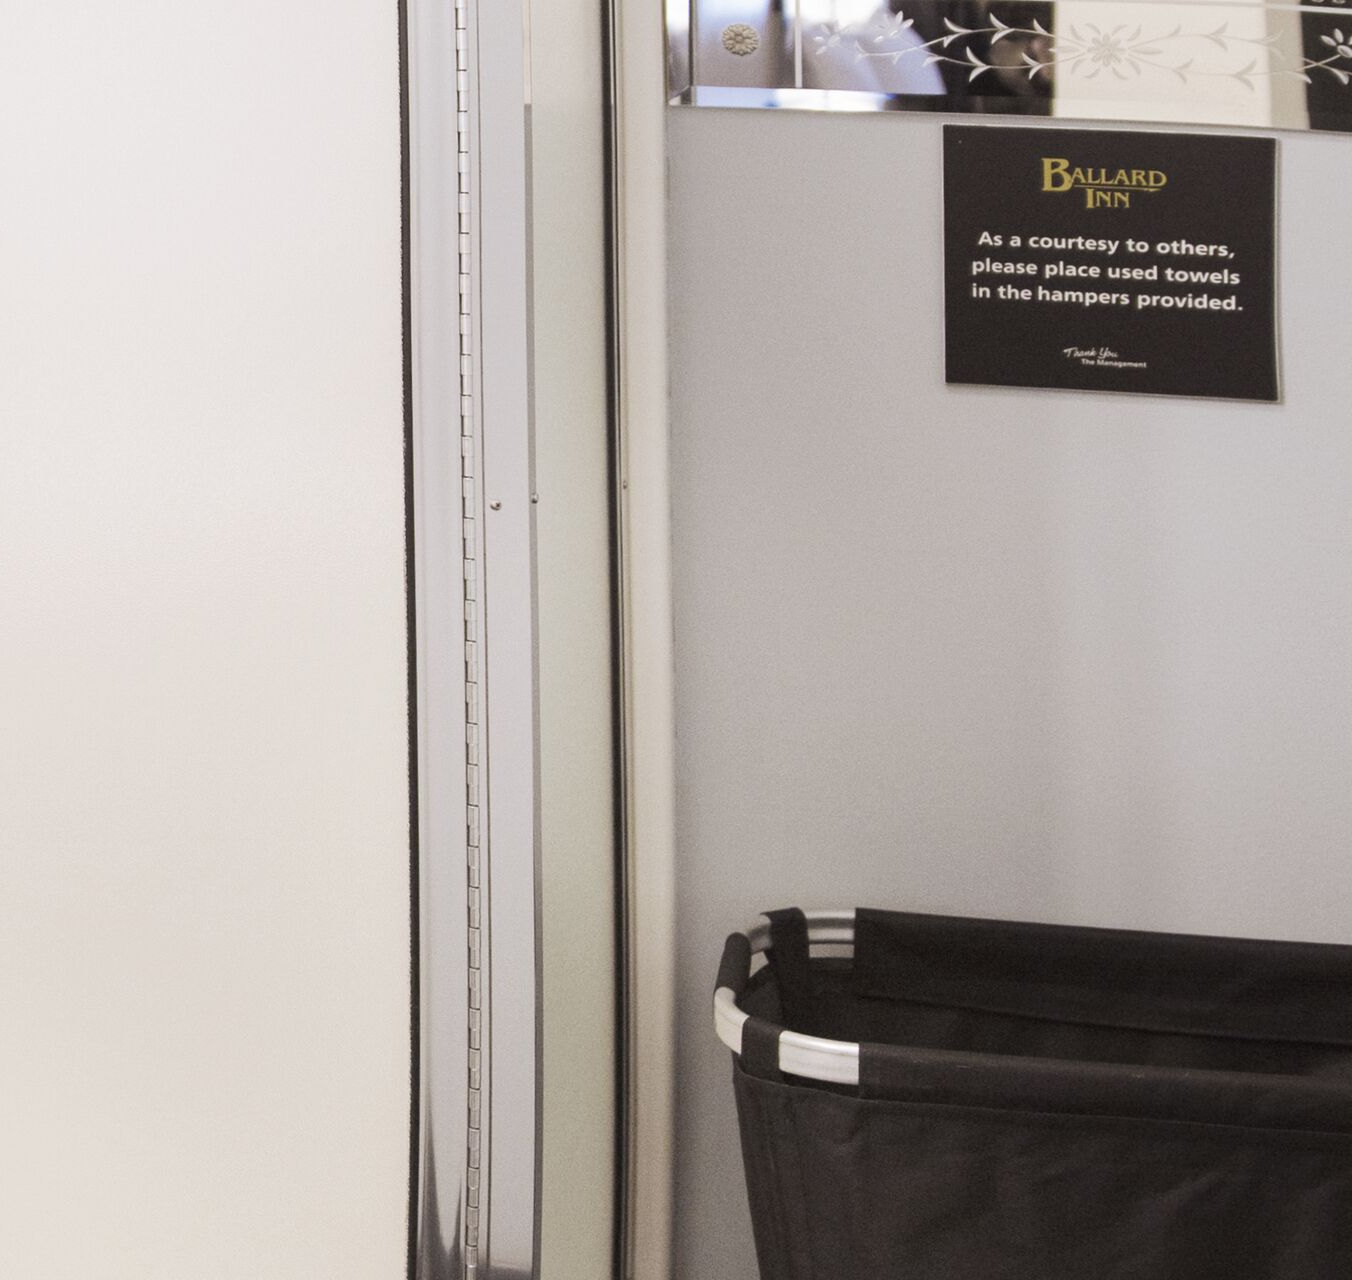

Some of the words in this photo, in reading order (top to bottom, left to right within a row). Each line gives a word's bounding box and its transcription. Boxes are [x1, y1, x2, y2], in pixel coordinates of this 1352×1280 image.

[1041, 157, 1168, 192] BALLARD
[1085, 187, 1131, 209] INN
[977, 231, 1003, 247] As
[1009, 235, 1022, 248] a
[1028, 235, 1120, 256] courtesy
[1125, 238, 1150, 254] to
[1155, 239, 1236, 260] others,
[971, 257, 1038, 276] please
[1044, 260, 1101, 279] place
[1107, 265, 1158, 281] used
[1164, 267, 1241, 286] towels
[971, 282, 991, 299] in
[997, 284, 1033, 301] the
[1037, 285, 1130, 307] hampers
[1137, 292, 1244, 312] provided.
[1062, 346, 1097, 358] Thank
[1080, 357, 1095, 366] The
[1096, 359, 1147, 369] Management
